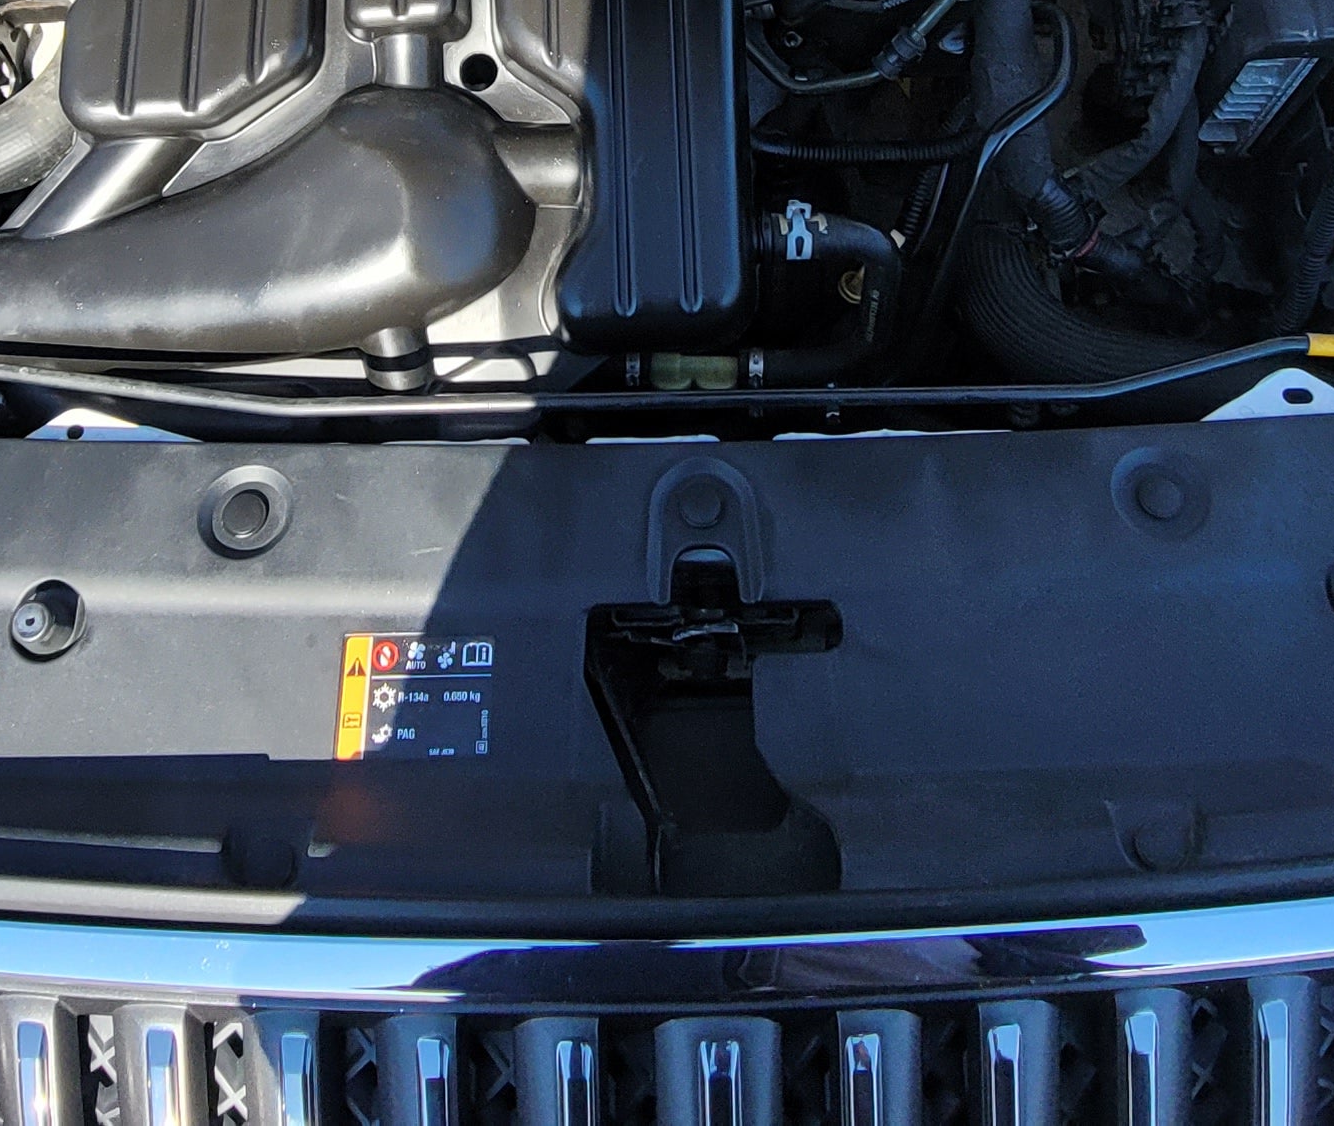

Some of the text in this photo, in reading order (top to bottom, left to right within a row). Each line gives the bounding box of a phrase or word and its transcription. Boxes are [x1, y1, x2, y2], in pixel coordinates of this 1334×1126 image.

[406, 660, 426, 671] AUTO
[397, 691, 429, 703] R-134a
[469, 690, 481, 703] kg
[397, 728, 416, 740] PAG
